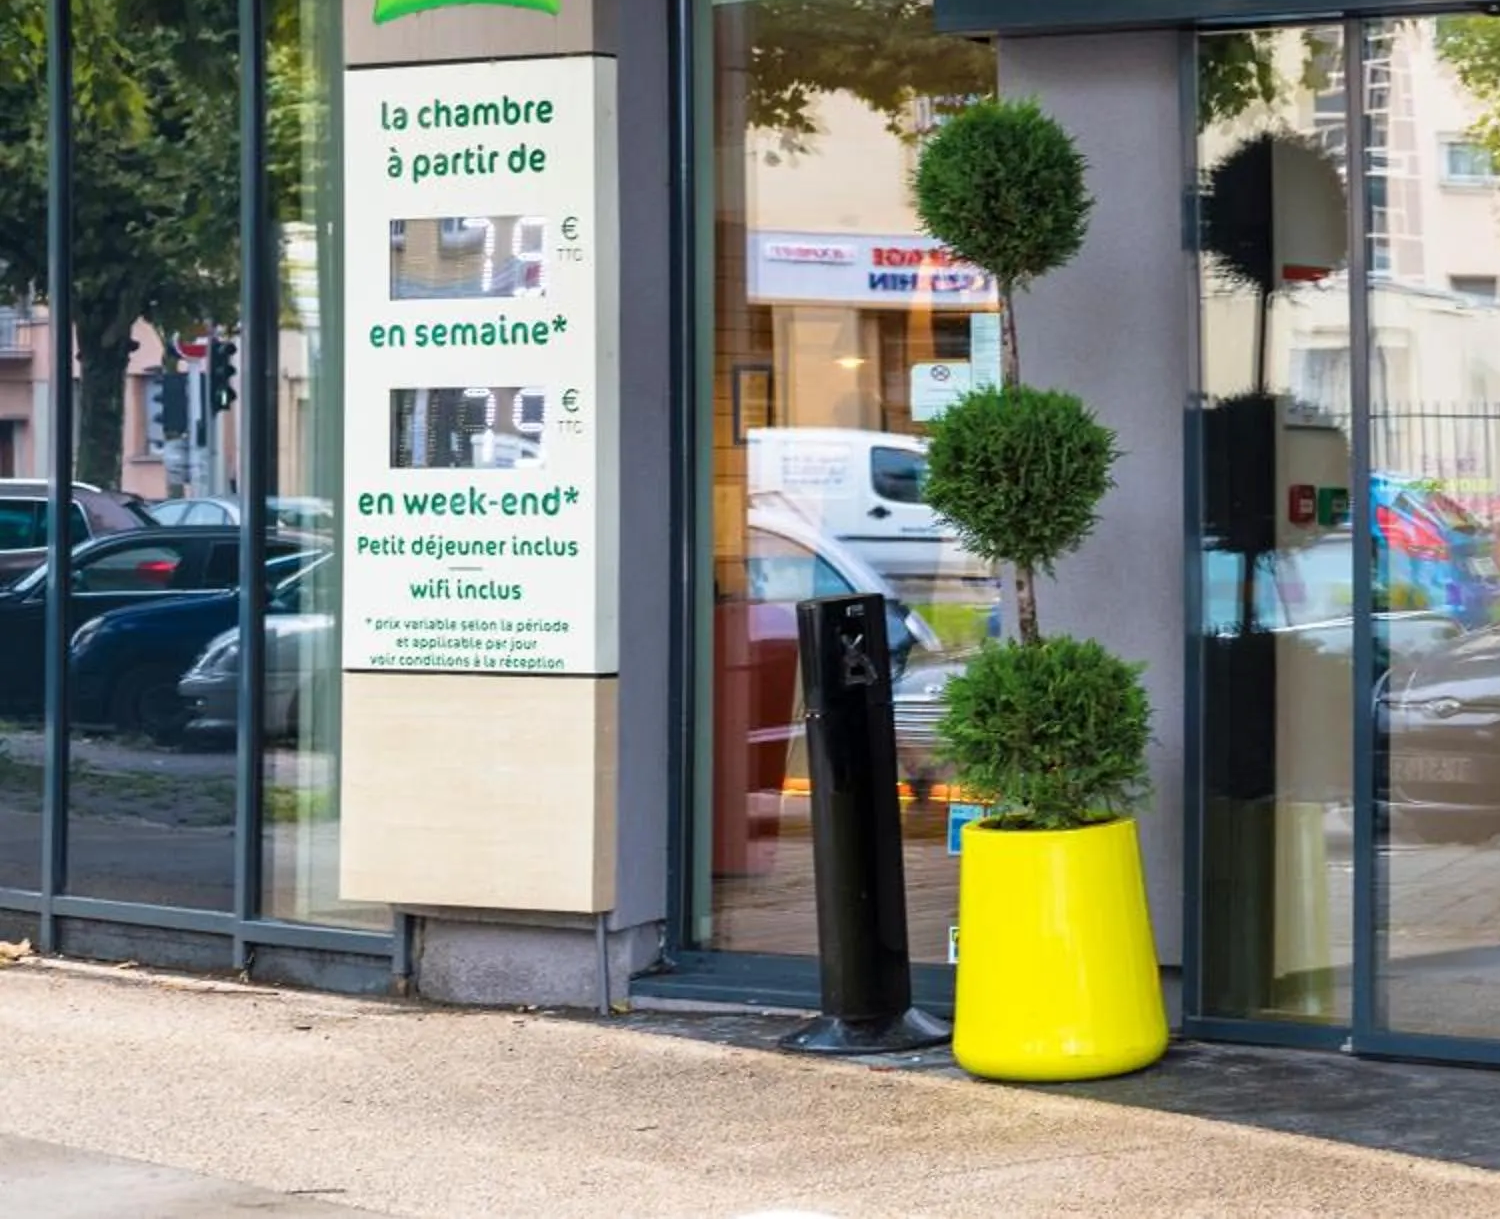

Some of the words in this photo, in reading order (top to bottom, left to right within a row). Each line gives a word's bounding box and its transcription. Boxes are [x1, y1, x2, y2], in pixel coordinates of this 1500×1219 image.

[382, 102, 408, 130] la
[418, 95, 553, 129] chambre
[388, 147, 402, 178] à
[413, 145, 500, 183] partir
[508, 143, 546, 173] de
[561, 217, 578, 241] €
[370, 325, 405, 348] en
[562, 388, 579, 413] €
[358, 493, 394, 515] en
[358, 536, 405, 556] Petit
[411, 535, 506, 560] déjeuner
[513, 536, 578, 556] inclus
[410, 579, 451, 599] wifi
[457, 579, 521, 600] inclus
[375, 620, 401, 632] prix
[404, 618, 457, 631] variable
[460, 619, 497, 631] selon
[501, 619, 513, 631] la
[516, 618, 569, 634] période
[396, 637, 409, 648] et
[412, 636, 482, 650] applicable
[485, 638, 507, 651] par
[510, 638, 537, 653] jour
[370, 654, 396, 666] voir
[399, 654, 470, 667] conditions
[484, 656, 496, 668] la
[499, 655, 564, 670] réception
